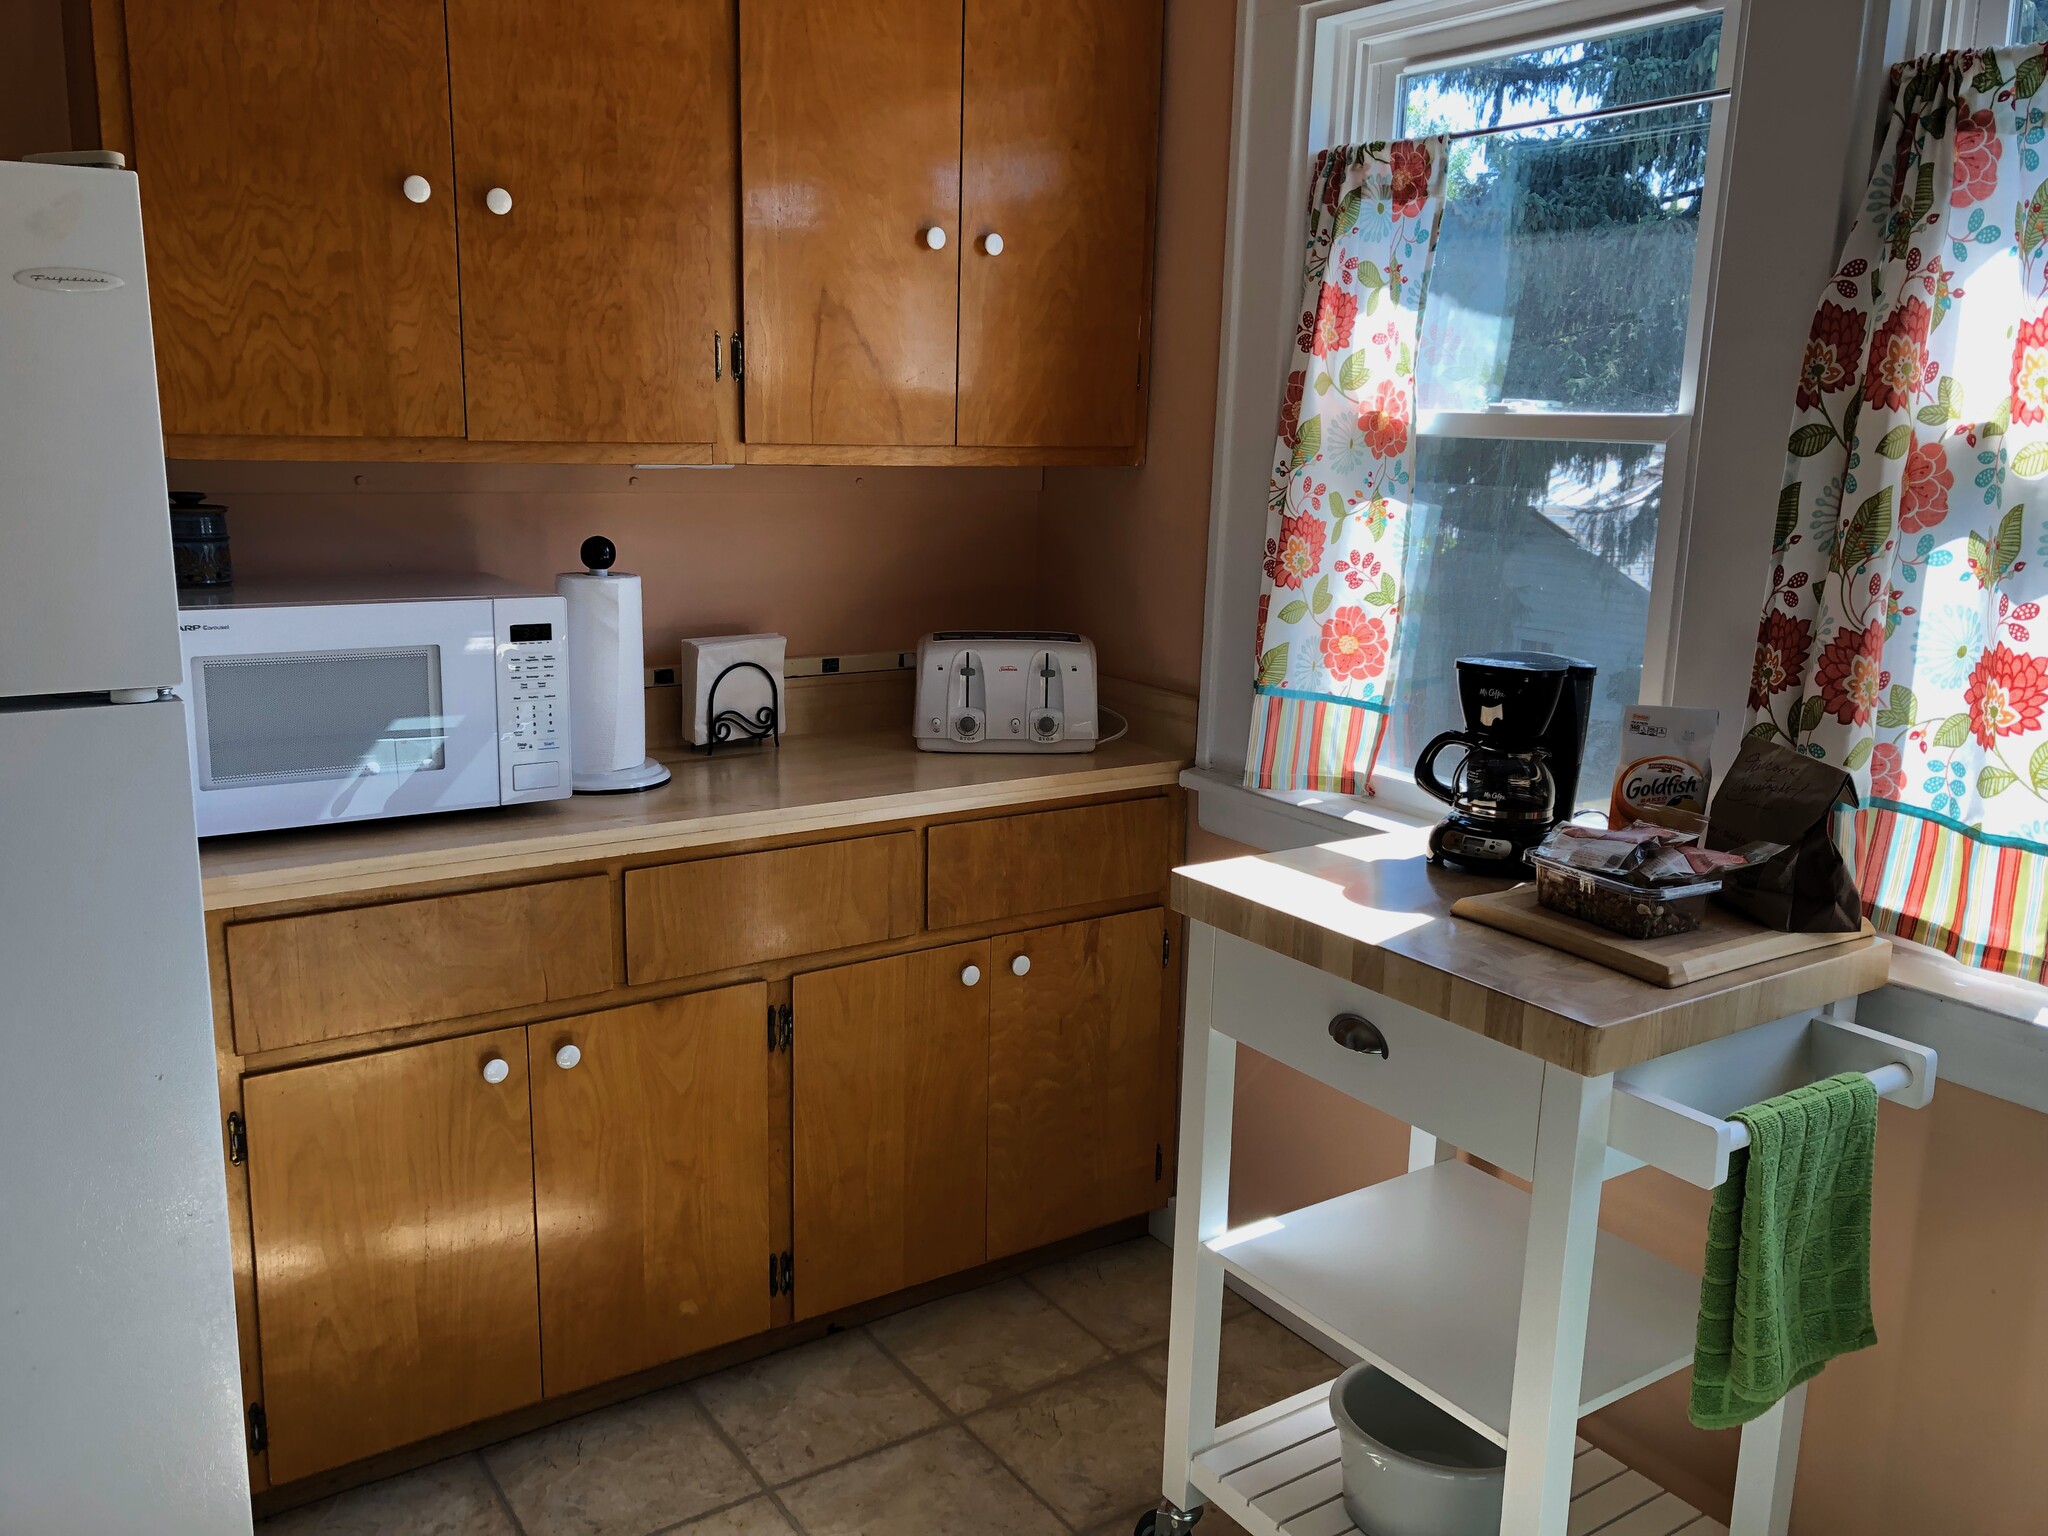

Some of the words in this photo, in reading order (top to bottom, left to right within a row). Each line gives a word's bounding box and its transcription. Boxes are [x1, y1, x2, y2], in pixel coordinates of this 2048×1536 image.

[30, 274, 109, 284] Frigidaire
[1626, 774, 1697, 799] Goldfish
[1640, 795, 1668, 804] BAKED
